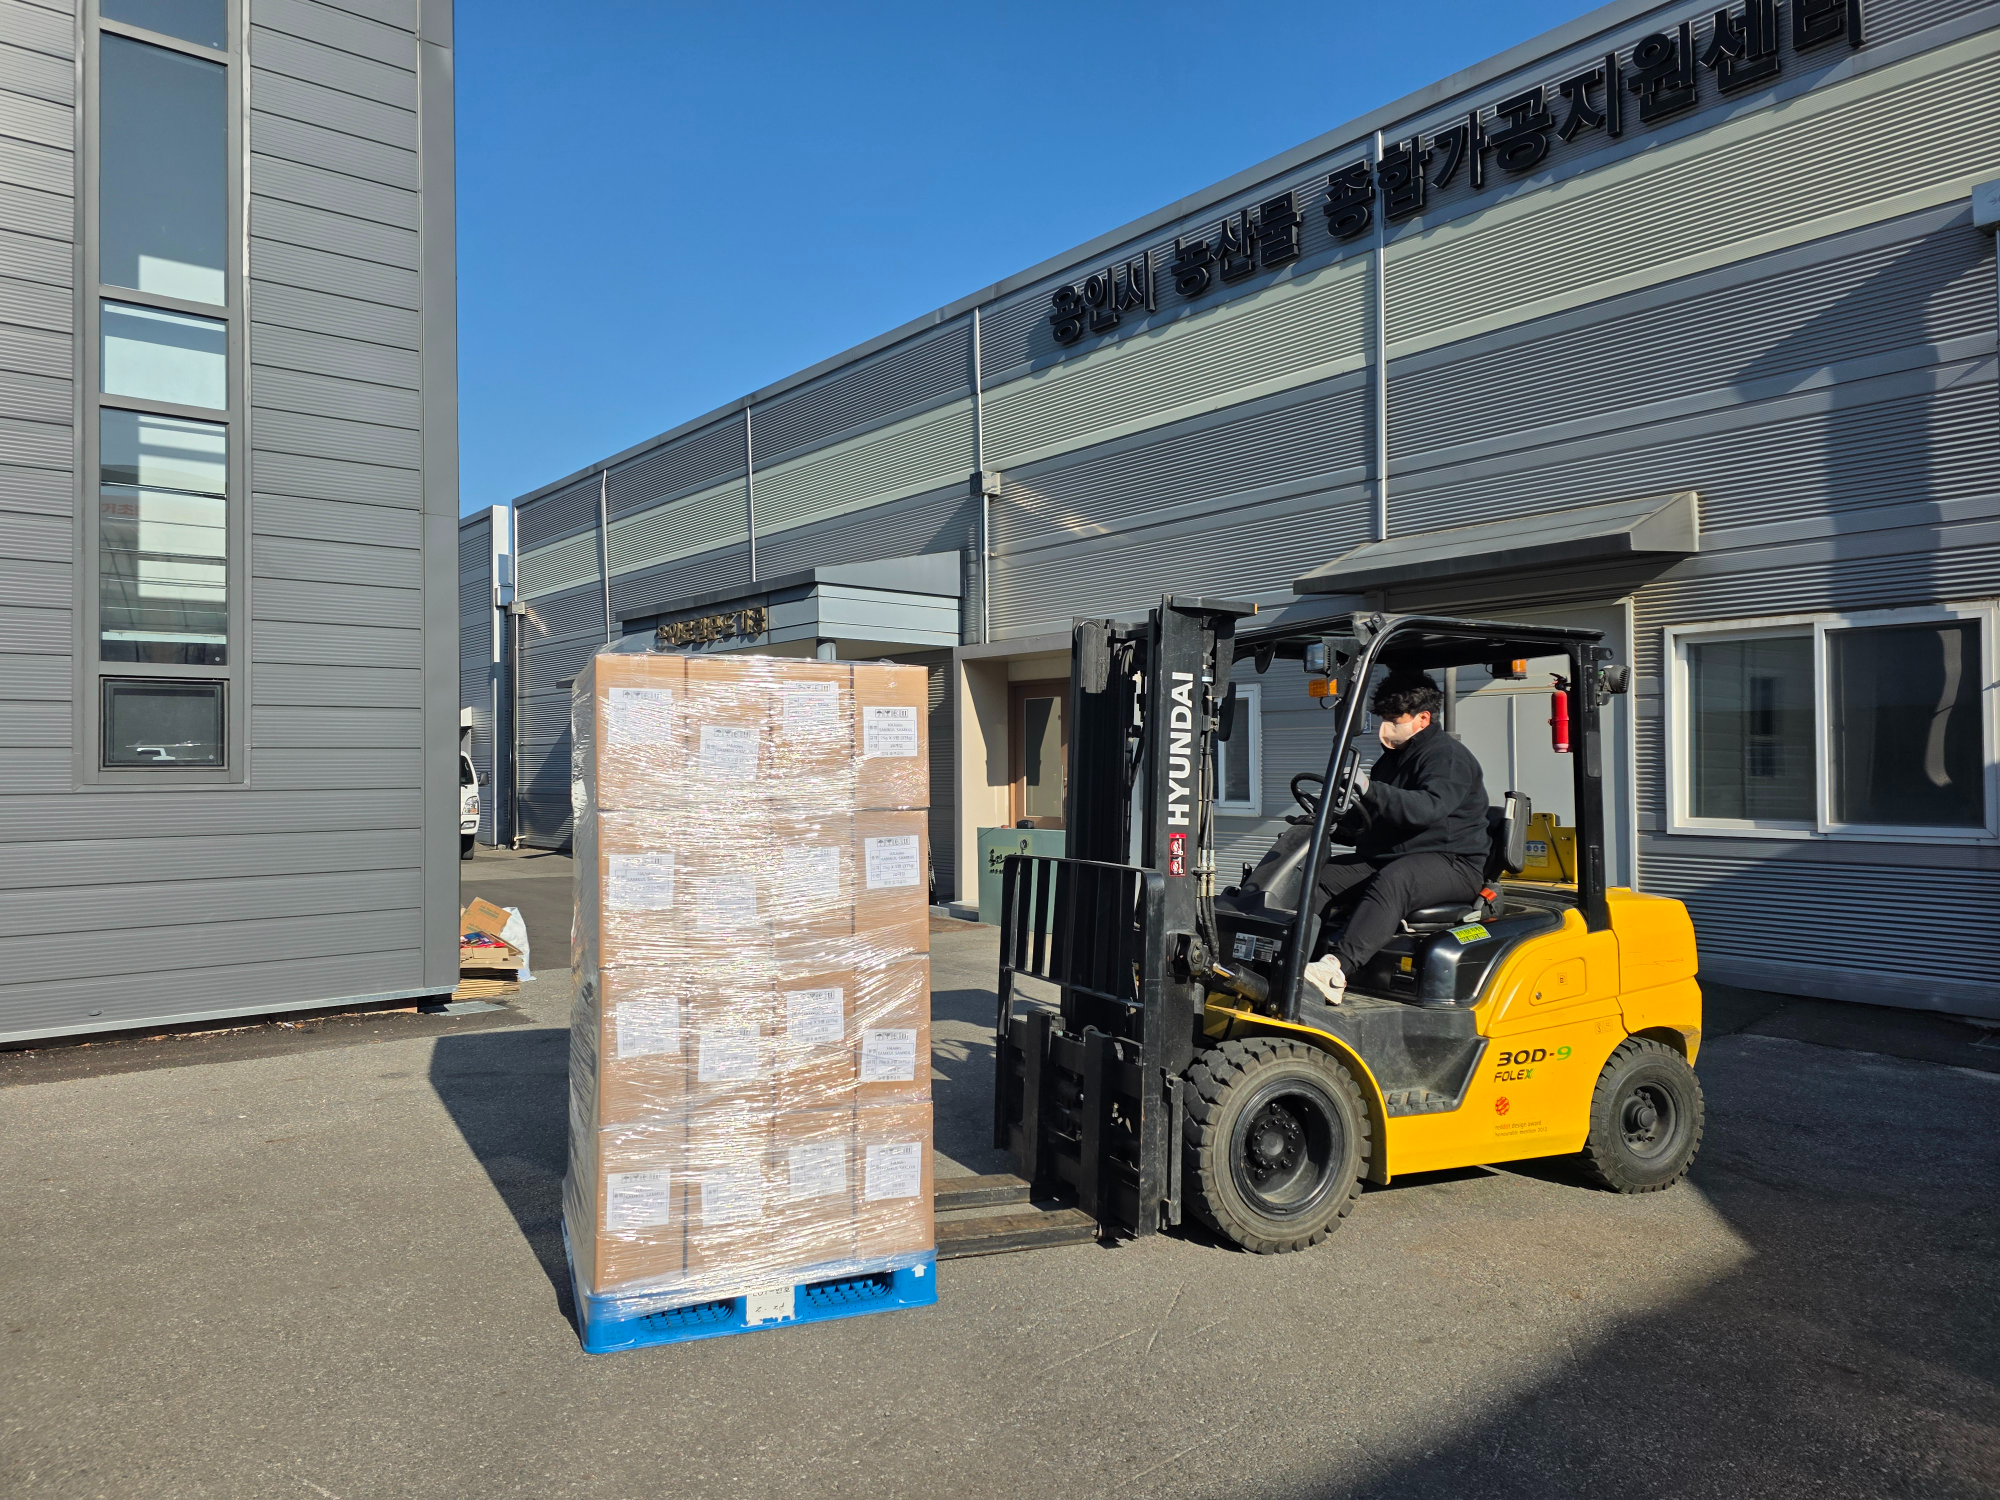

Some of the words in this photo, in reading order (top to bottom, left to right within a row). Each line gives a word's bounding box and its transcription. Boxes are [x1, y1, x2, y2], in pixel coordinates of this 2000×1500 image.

[1049, 250, 1156, 344] 용인시
[1170, 190, 1302, 298] 농산물
[1322, 0, 1866, 239] 종합가공지원센터
[1167, 671, 1195, 826] HYUNDAI
[1496, 1045, 1573, 1067] 30D-9
[1493, 1068, 1535, 1084] FOLEX
[1512, 1121, 1527, 1130] design
[1527, 1119, 1542, 1127] award
[1519, 1127, 1537, 1135] mention
